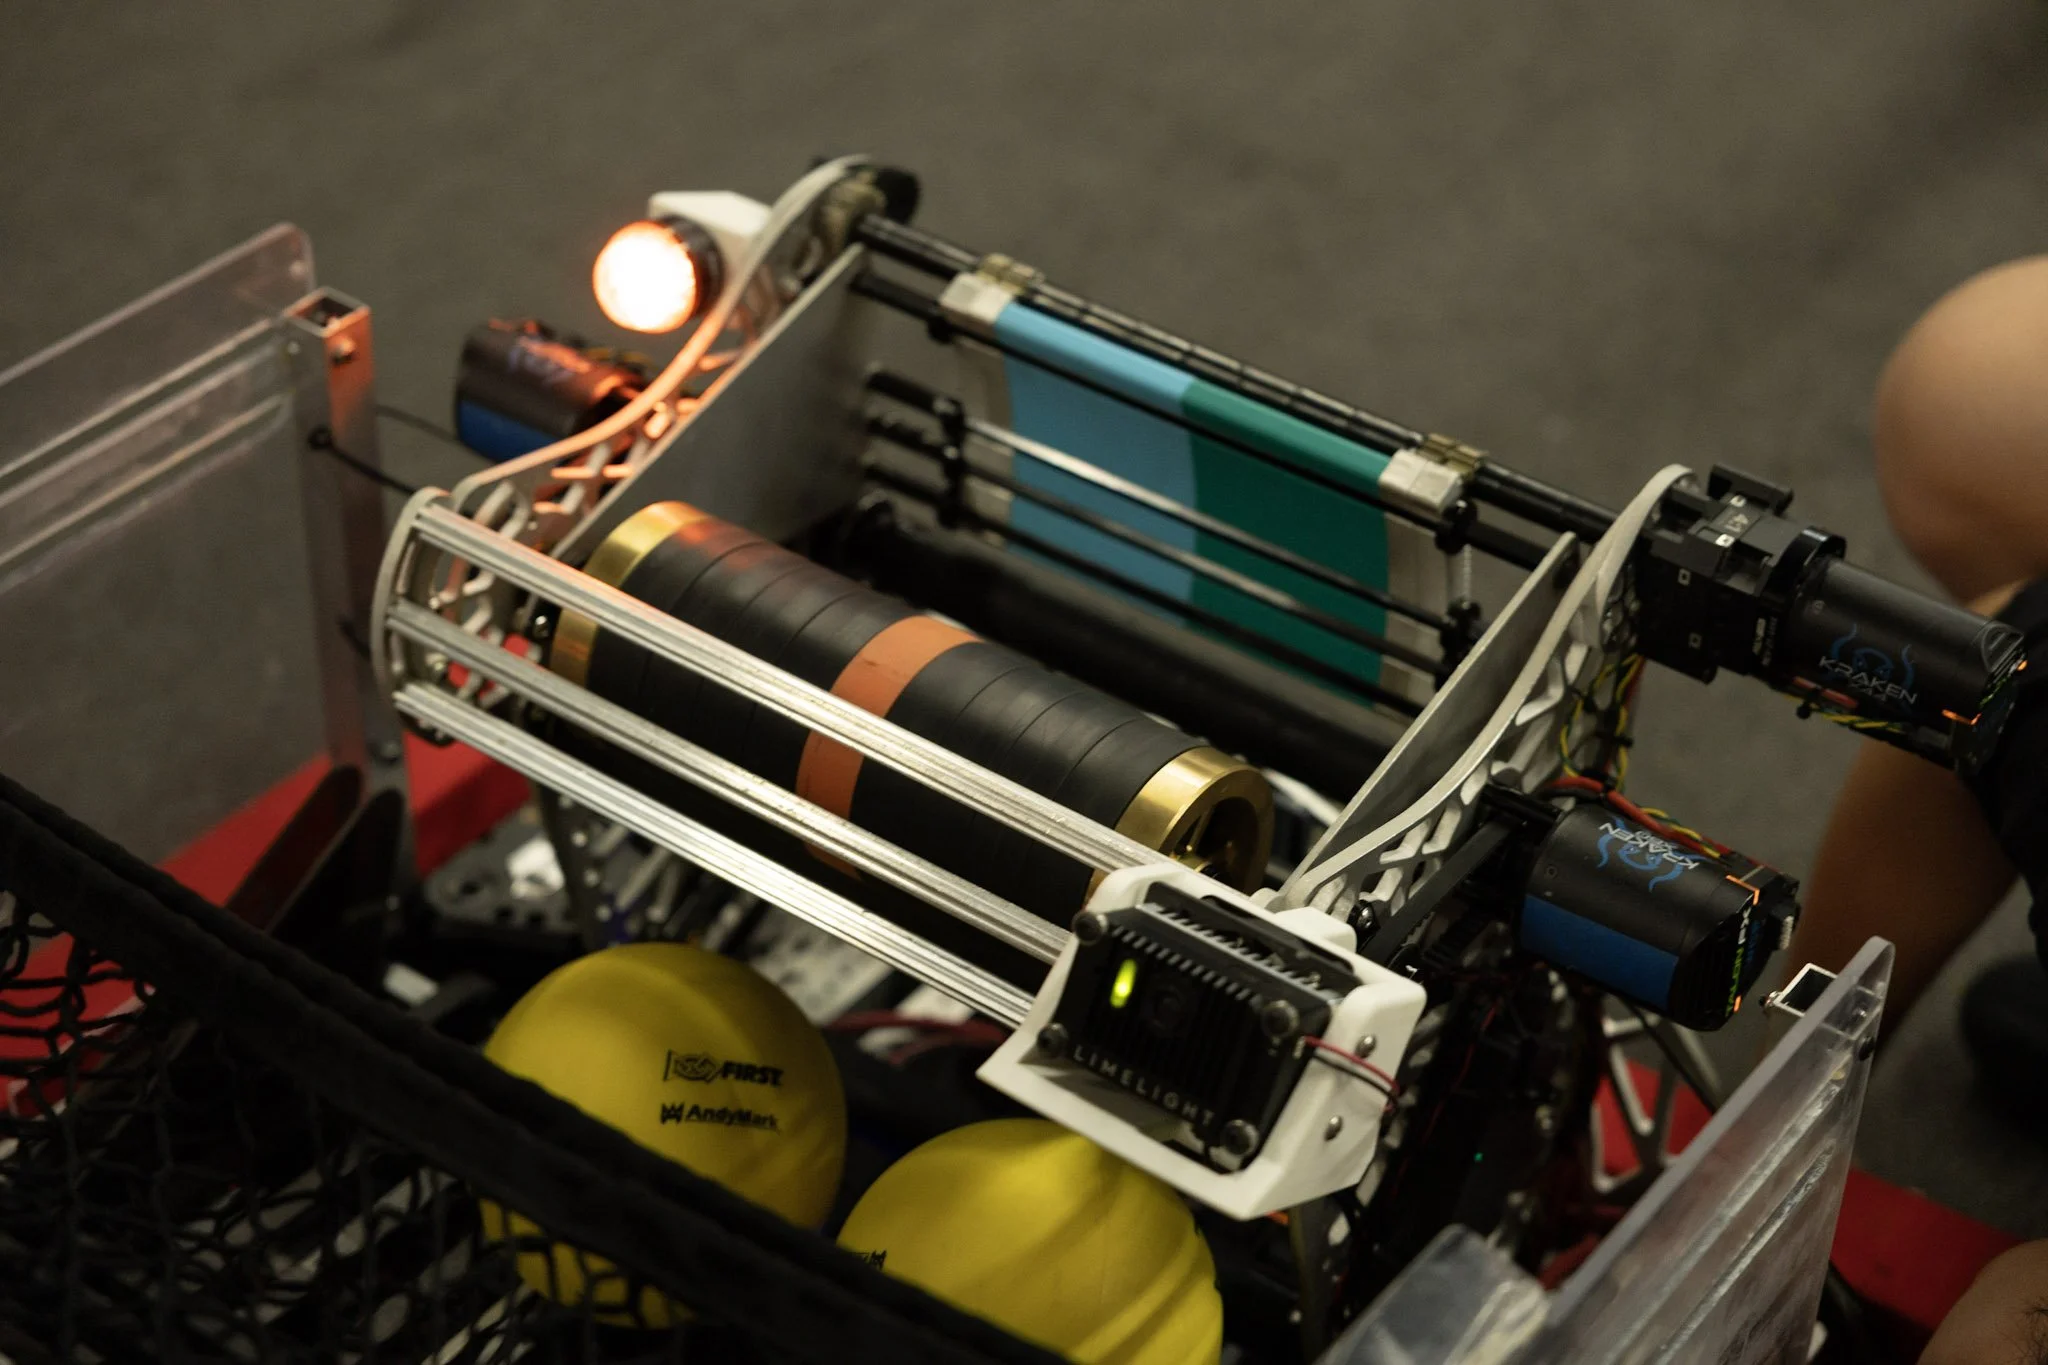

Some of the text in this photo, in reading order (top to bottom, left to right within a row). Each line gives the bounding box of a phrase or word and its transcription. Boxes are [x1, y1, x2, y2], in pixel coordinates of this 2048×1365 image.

[1818, 655, 1918, 704] KRAKEN
[1599, 822, 1699, 870] KRAKEN
[722, 1060, 784, 1087] FIRST
[1073, 1045, 1215, 1126] LIMELIGHT
[686, 1104, 777, 1129] AndyMark
